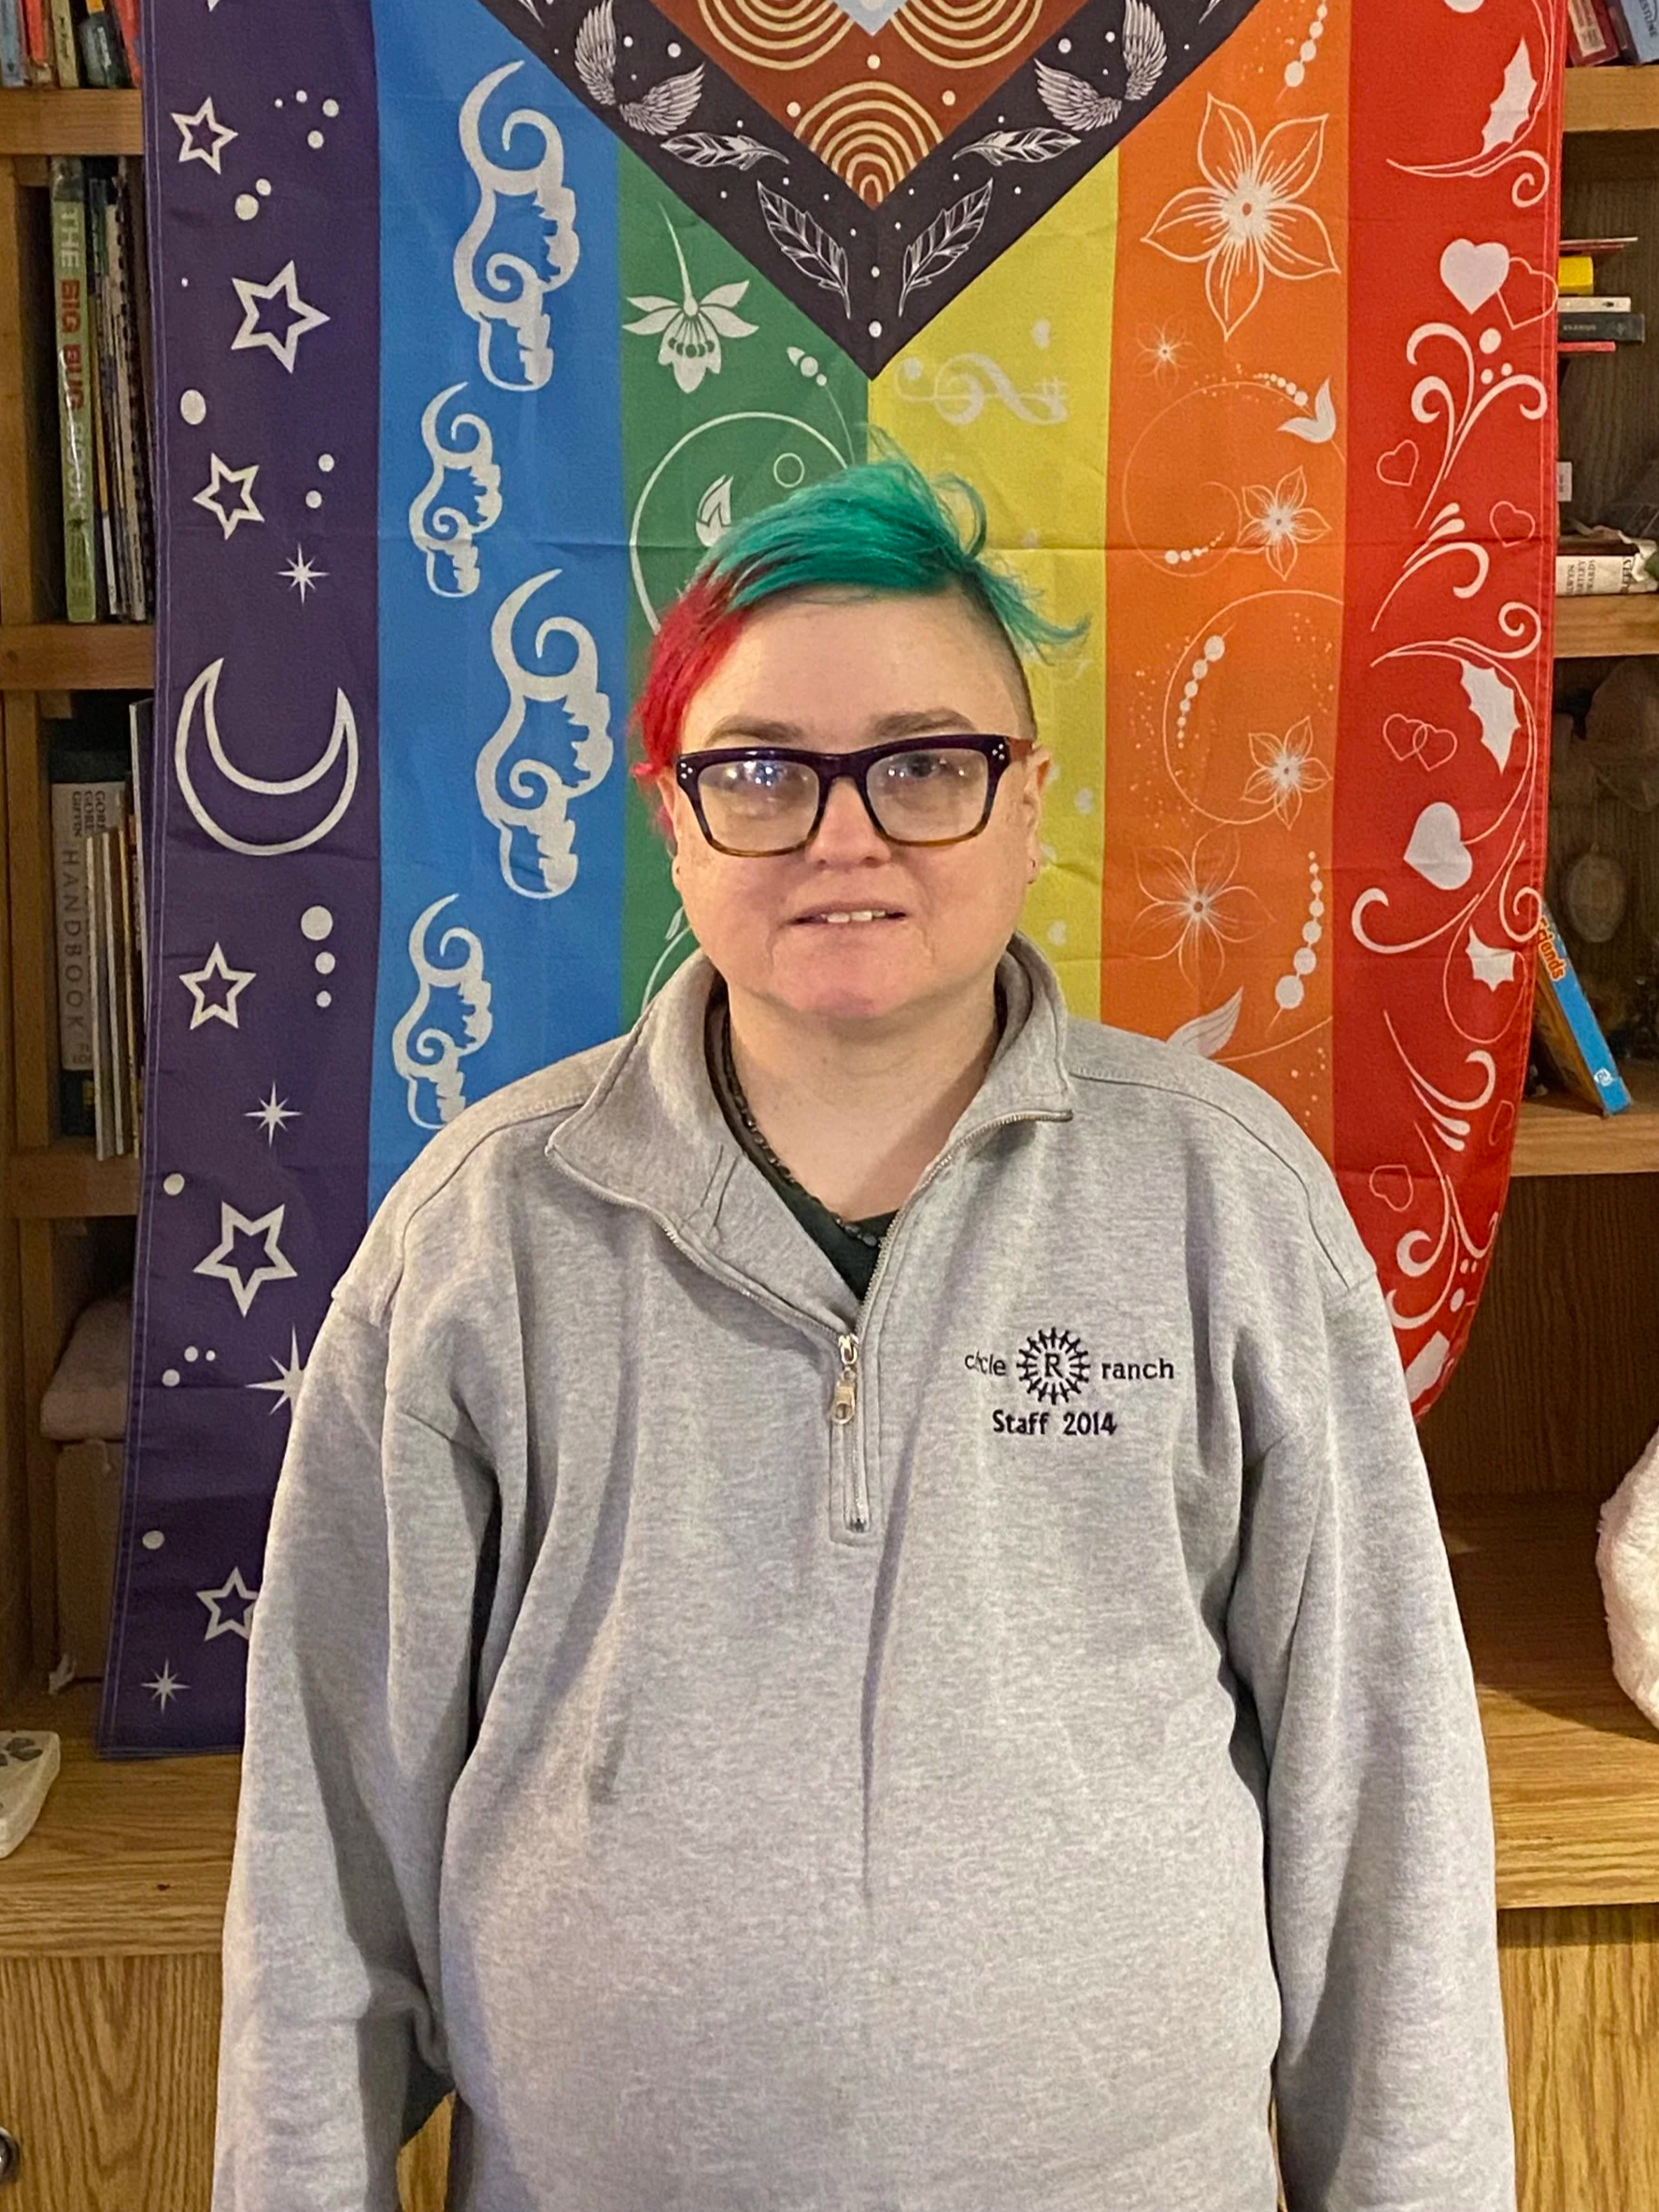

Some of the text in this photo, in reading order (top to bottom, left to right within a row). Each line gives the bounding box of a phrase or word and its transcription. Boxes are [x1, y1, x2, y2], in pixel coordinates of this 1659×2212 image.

[61, 207, 80, 268] THE
[61, 279, 81, 333] BIG
[64, 344, 86, 409] BUG
[66, 420, 88, 511] BOOK
[62, 848, 85, 1028] HANDBOOK
[1044, 1354, 1064, 1379] R
[1100, 1357, 1175, 1380] ranch
[992, 1409, 1117, 1436] Staff 2014
